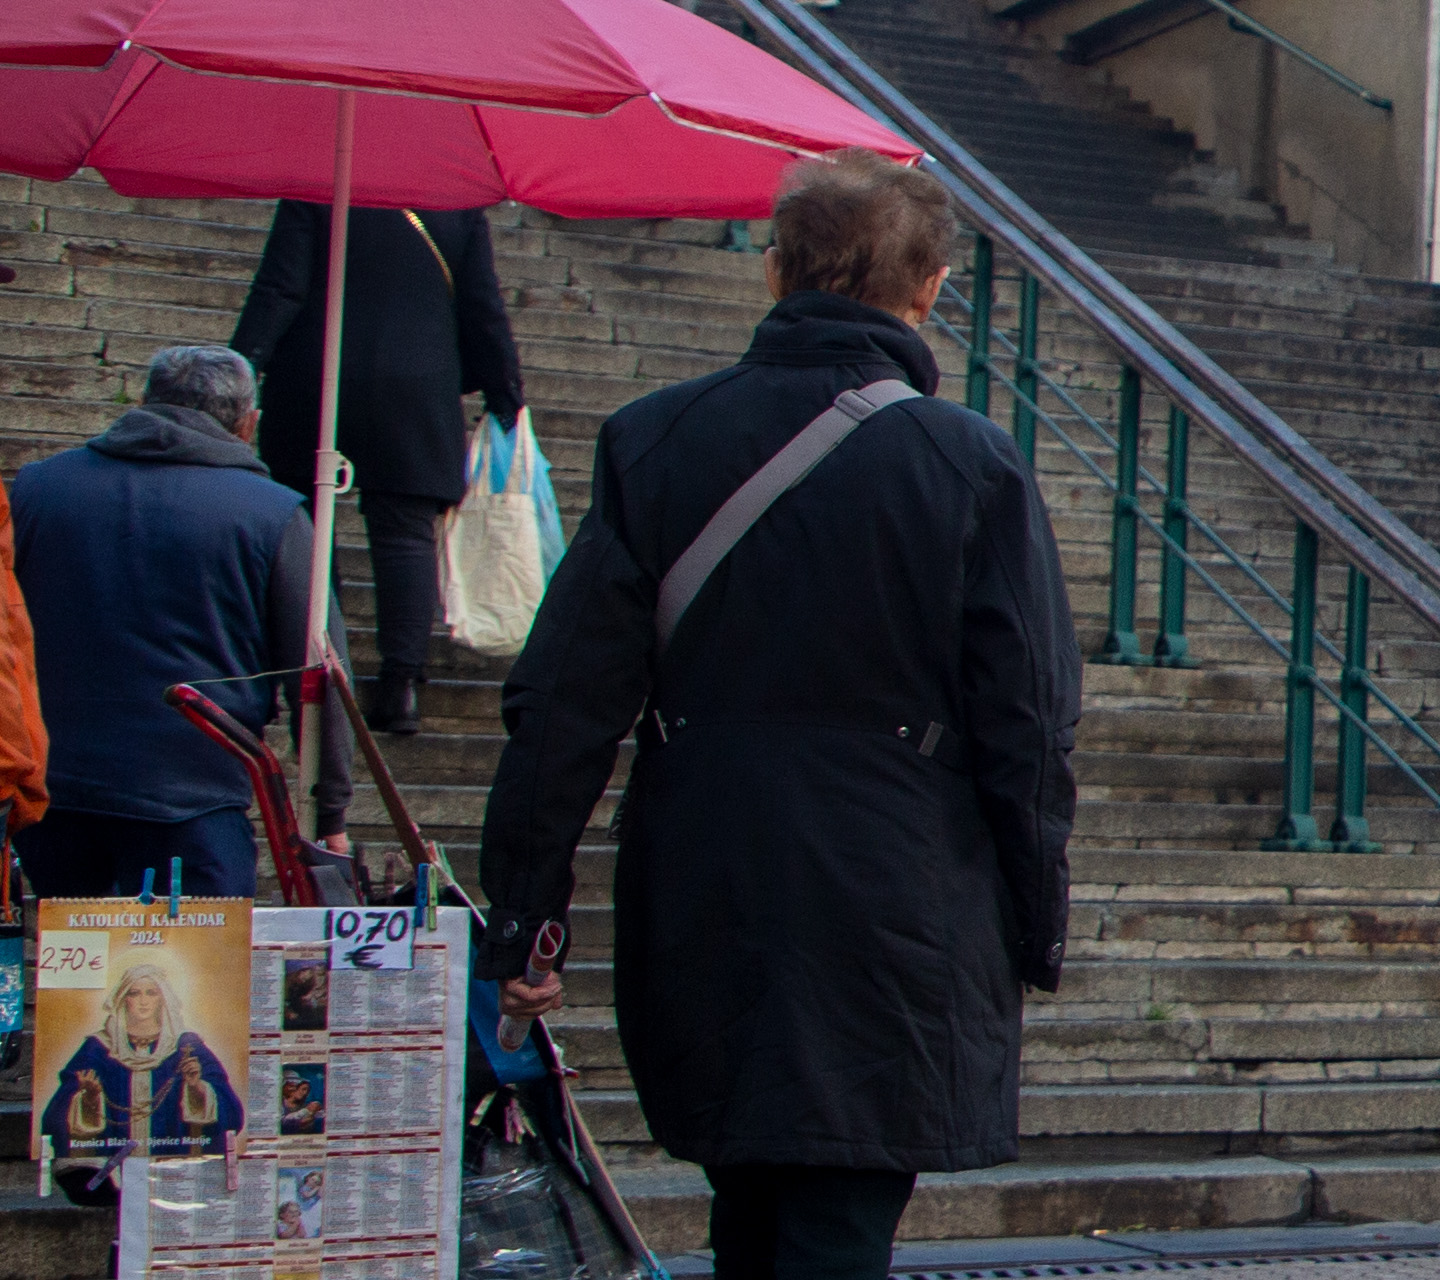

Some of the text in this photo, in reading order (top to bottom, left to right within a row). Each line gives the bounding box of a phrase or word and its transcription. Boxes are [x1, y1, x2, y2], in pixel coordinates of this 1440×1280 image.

[68, 910, 226, 928] KATOLIČKI KALENDAR
[335, 909, 409, 944] 0,70
[129, 931, 165, 946] 2024.
[39, 946, 105, 974] 2,70 €
[343, 944, 386, 968] €
